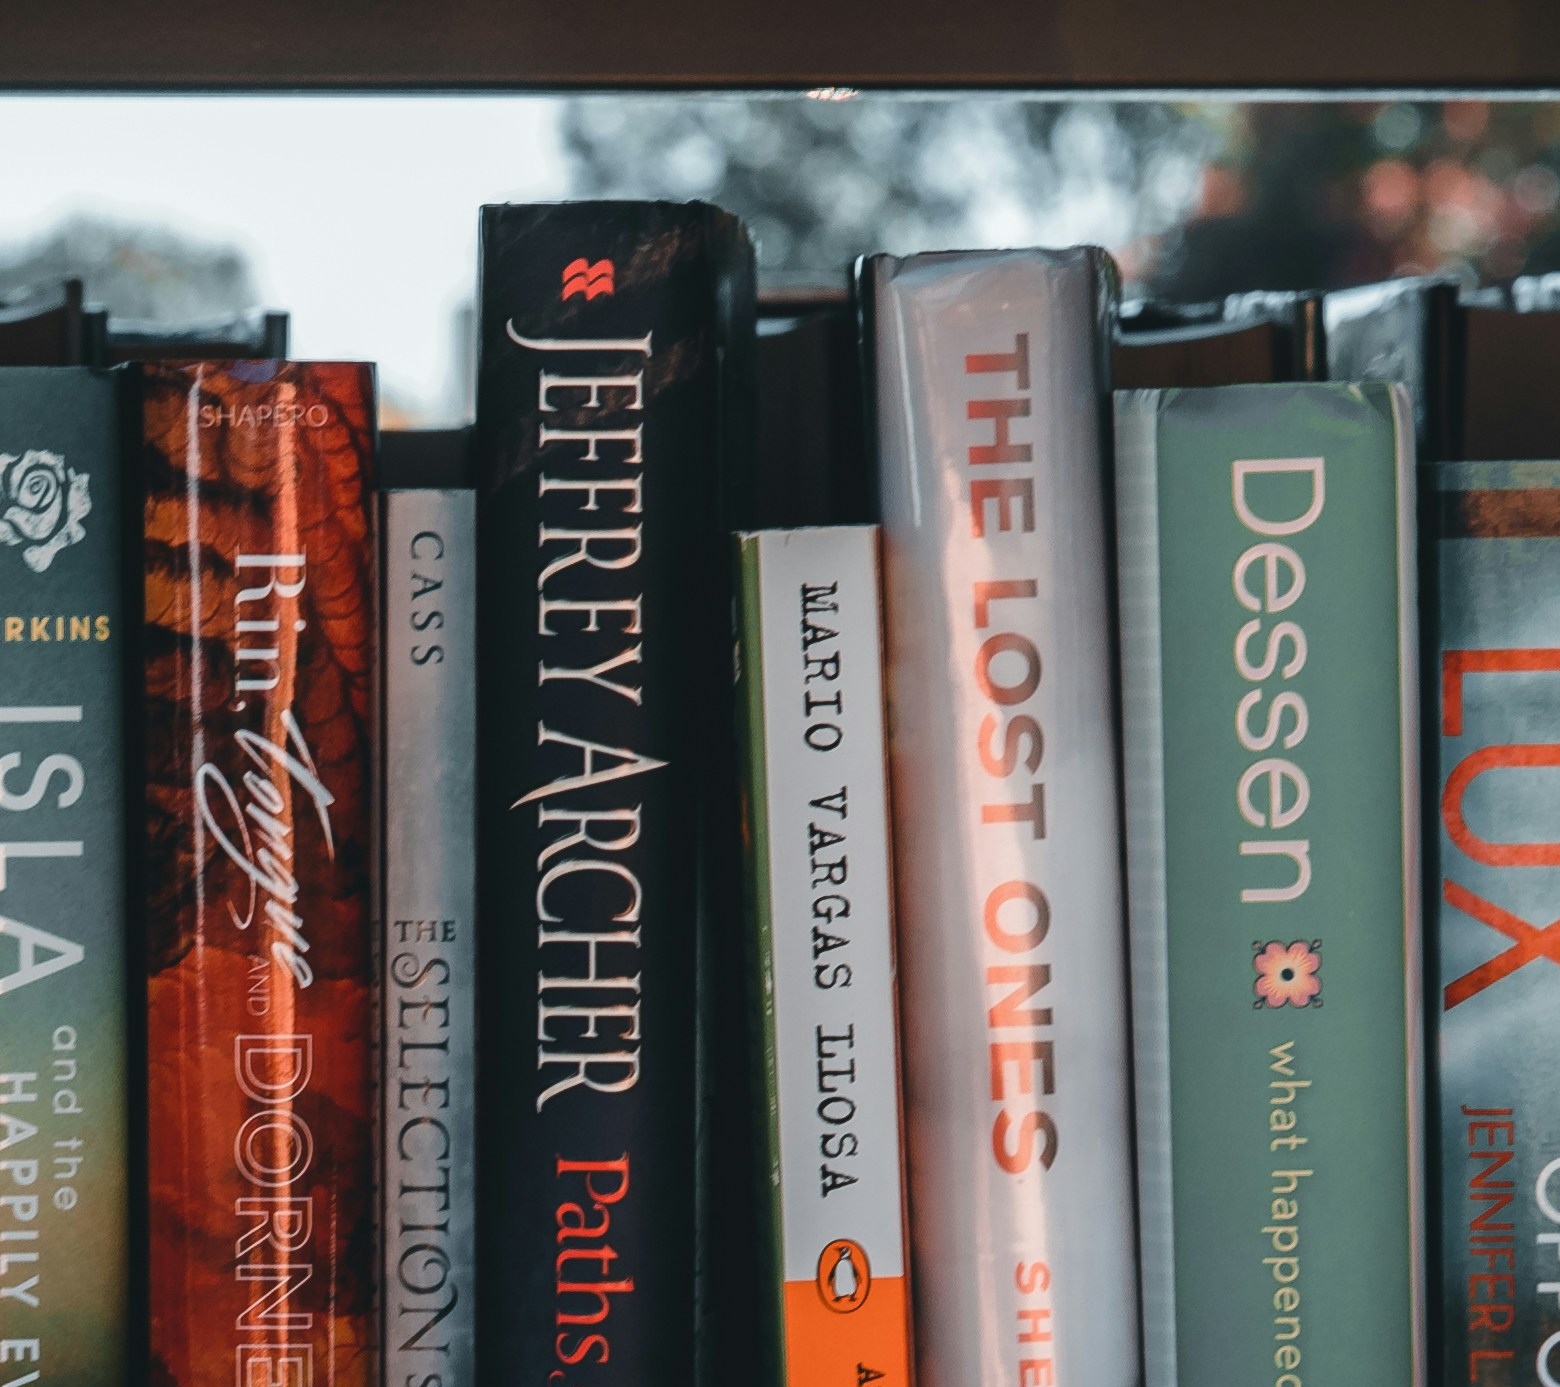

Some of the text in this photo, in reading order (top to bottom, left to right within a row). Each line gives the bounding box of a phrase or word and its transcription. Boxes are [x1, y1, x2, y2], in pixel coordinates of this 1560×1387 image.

[506, 318, 672, 1113] JEFFREY ARCHER
[1231, 456, 1326, 905] Dessen
[801, 581, 860, 1199] MARIO VARGAS LLOSA
[52, 1023, 79, 1211] and the
[552, 1152, 635, 1365] Paths
[1268, 1041, 1313, 1153] what
